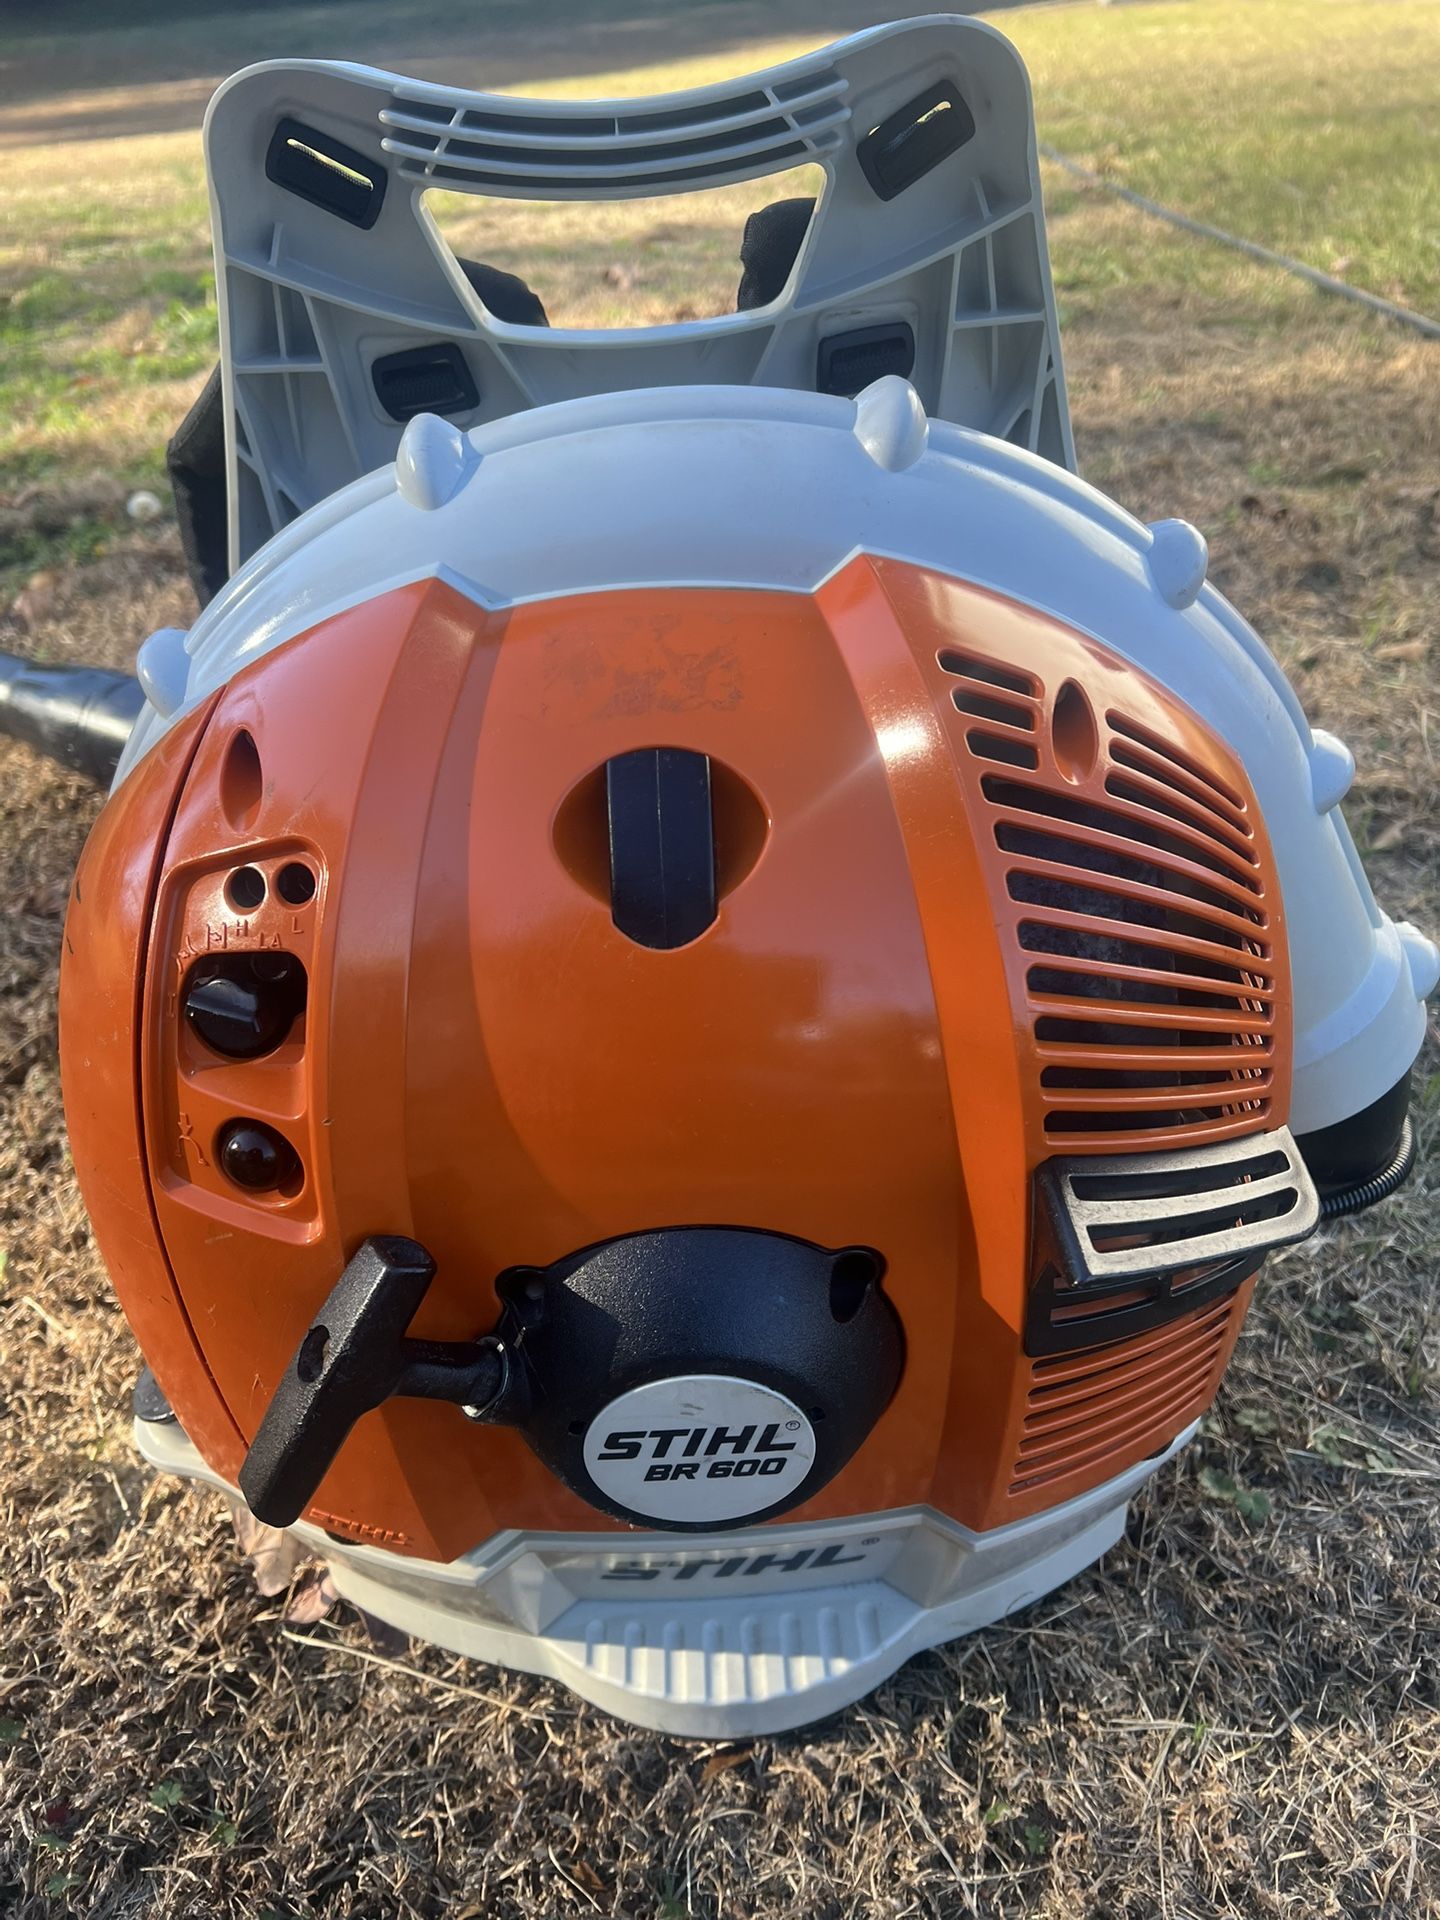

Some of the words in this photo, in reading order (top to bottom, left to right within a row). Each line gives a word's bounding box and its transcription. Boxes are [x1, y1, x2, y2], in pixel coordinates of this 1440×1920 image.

[291, 916, 305, 935] L
[259, 932, 282, 950] LA
[597, 1423, 797, 1461] STIHL
[643, 1463, 700, 1482] BR
[706, 1457, 788, 1479] 600
[599, 1544, 867, 1581] STIHL
